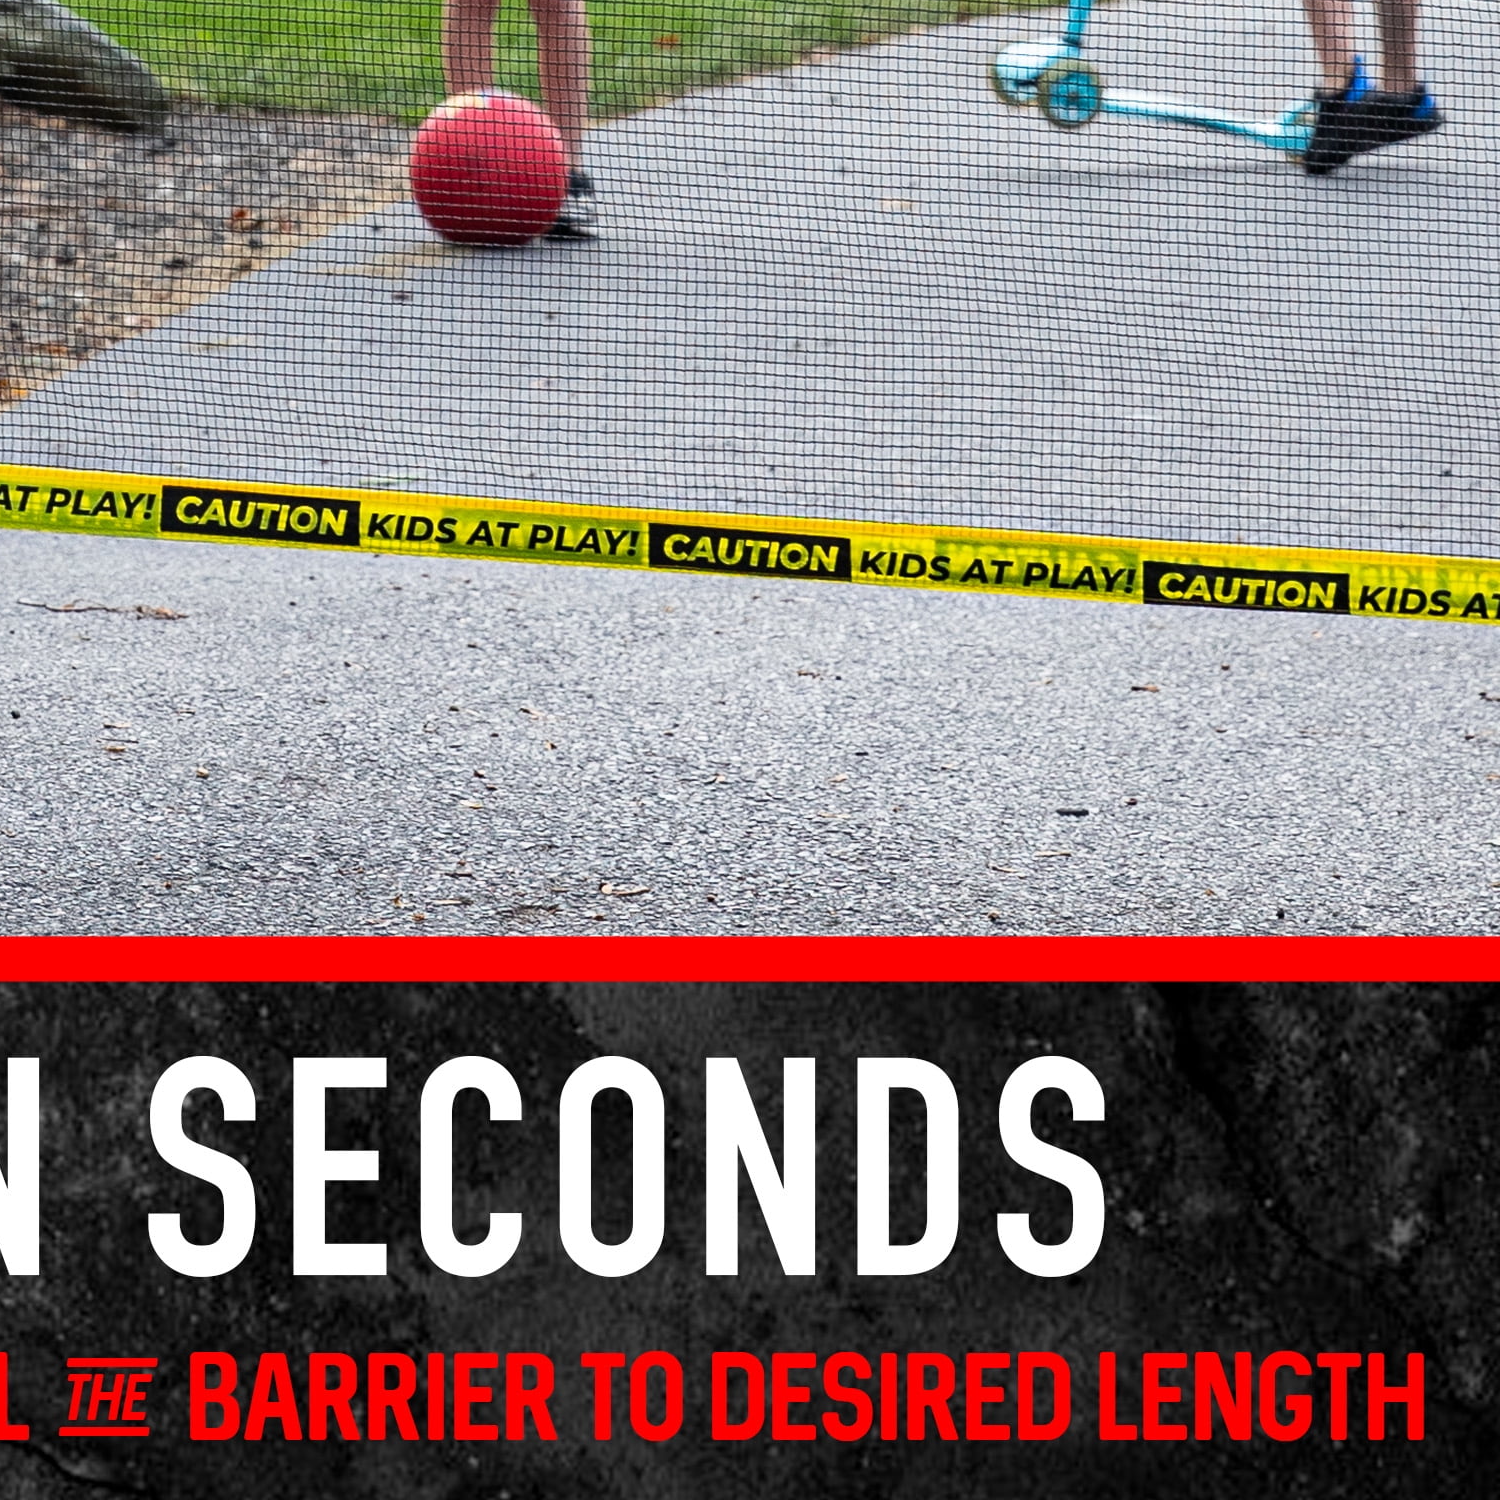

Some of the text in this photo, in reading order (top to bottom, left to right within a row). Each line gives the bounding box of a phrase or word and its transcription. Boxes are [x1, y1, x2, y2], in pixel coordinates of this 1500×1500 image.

[45, 487, 157, 520] PLAY!
[175, 495, 348, 536] CAUTION
[367, 513, 458, 544] KIDS
[466, 520, 520, 548] AT
[527, 524, 639, 557] PLAY!
[663, 533, 840, 573] CAUTION
[859, 550, 951, 582] KIDS
[959, 558, 1014, 585] AT
[1022, 561, 1137, 595] PLAY!
[1158, 572, 1337, 609] CAUTION
[1358, 585, 1452, 617] KIDS
